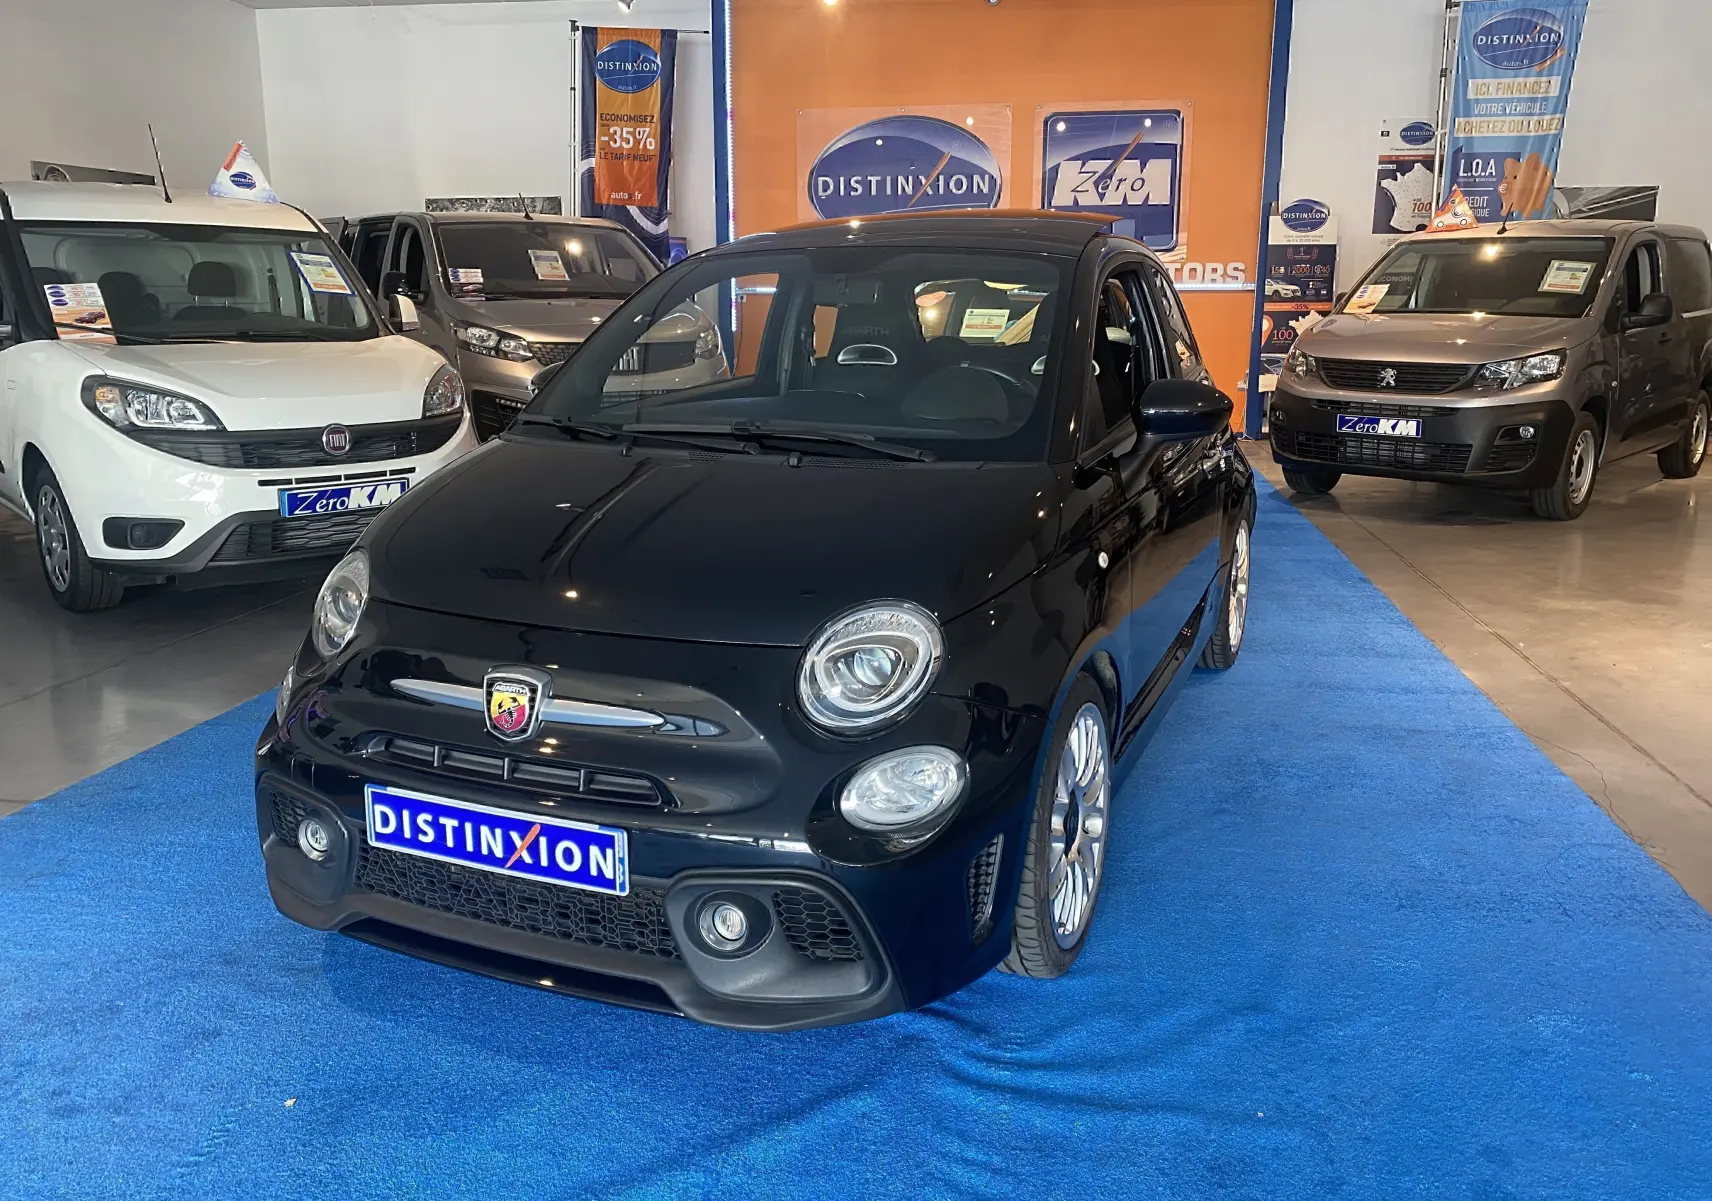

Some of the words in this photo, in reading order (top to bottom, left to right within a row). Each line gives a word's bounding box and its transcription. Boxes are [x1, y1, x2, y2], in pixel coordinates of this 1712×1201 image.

[1478, 32, 1559, 45] DISTINXION
[597, 61, 657, 71] DISTINXION
[1495, 79, 1551, 95] FINANCEZ
[1474, 103, 1503, 114] VOTRE
[1505, 100, 1548, 114] VÉHICULE
[600, 112, 656, 123] ECONOMISEZ
[1456, 120, 1505, 134] ACHETEZ
[1508, 119, 1524, 133] OU
[1526, 117, 1561, 132] LOUEZ
[601, 126, 655, 150] -35%
[599, 152, 609, 160] LE
[610, 153, 632, 161] TARIF
[817, 173, 990, 197] DISTINXION
[1051, 158, 1173, 207] KM
[1412, 202, 1432, 213] 100
[1272, 329, 1294, 340] 100
[495, 685, 527, 695] ABARTH
[373, 803, 616, 881] DISTINXION
